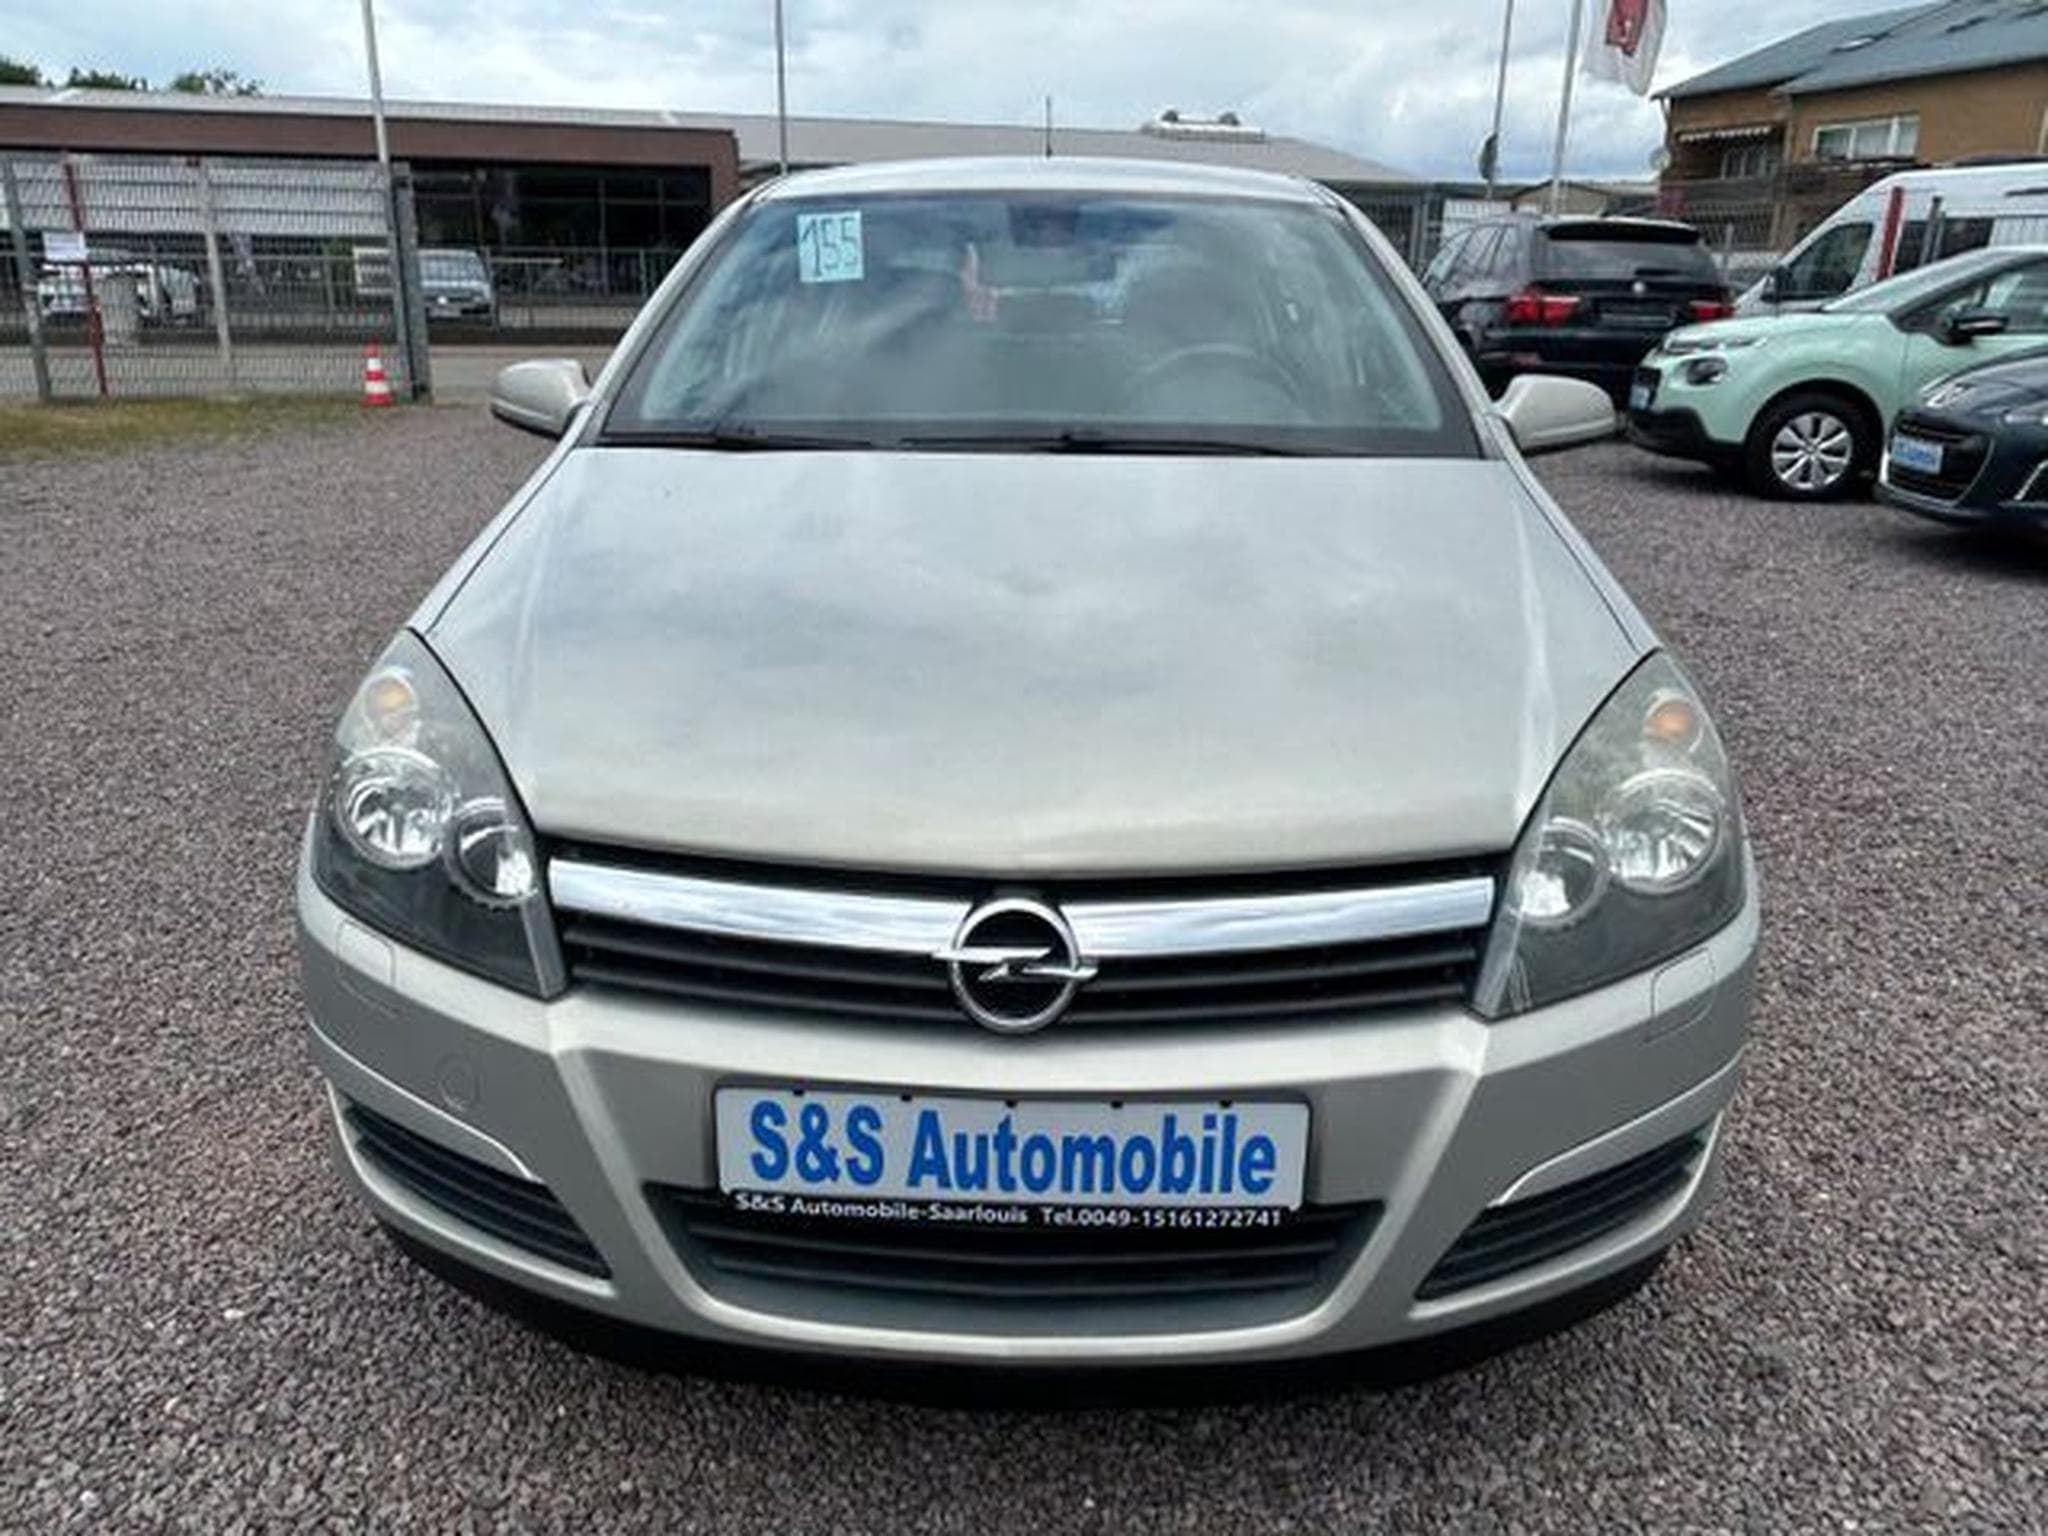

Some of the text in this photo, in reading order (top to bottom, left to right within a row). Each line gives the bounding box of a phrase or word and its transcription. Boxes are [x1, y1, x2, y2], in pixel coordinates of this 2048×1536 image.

[801, 217, 859, 277] 155
[748, 1099, 1277, 1196] S&S Automobile
[734, 1193, 785, 1212] S&S
[790, 1198, 1028, 1224] Automobile-Saarlouis
